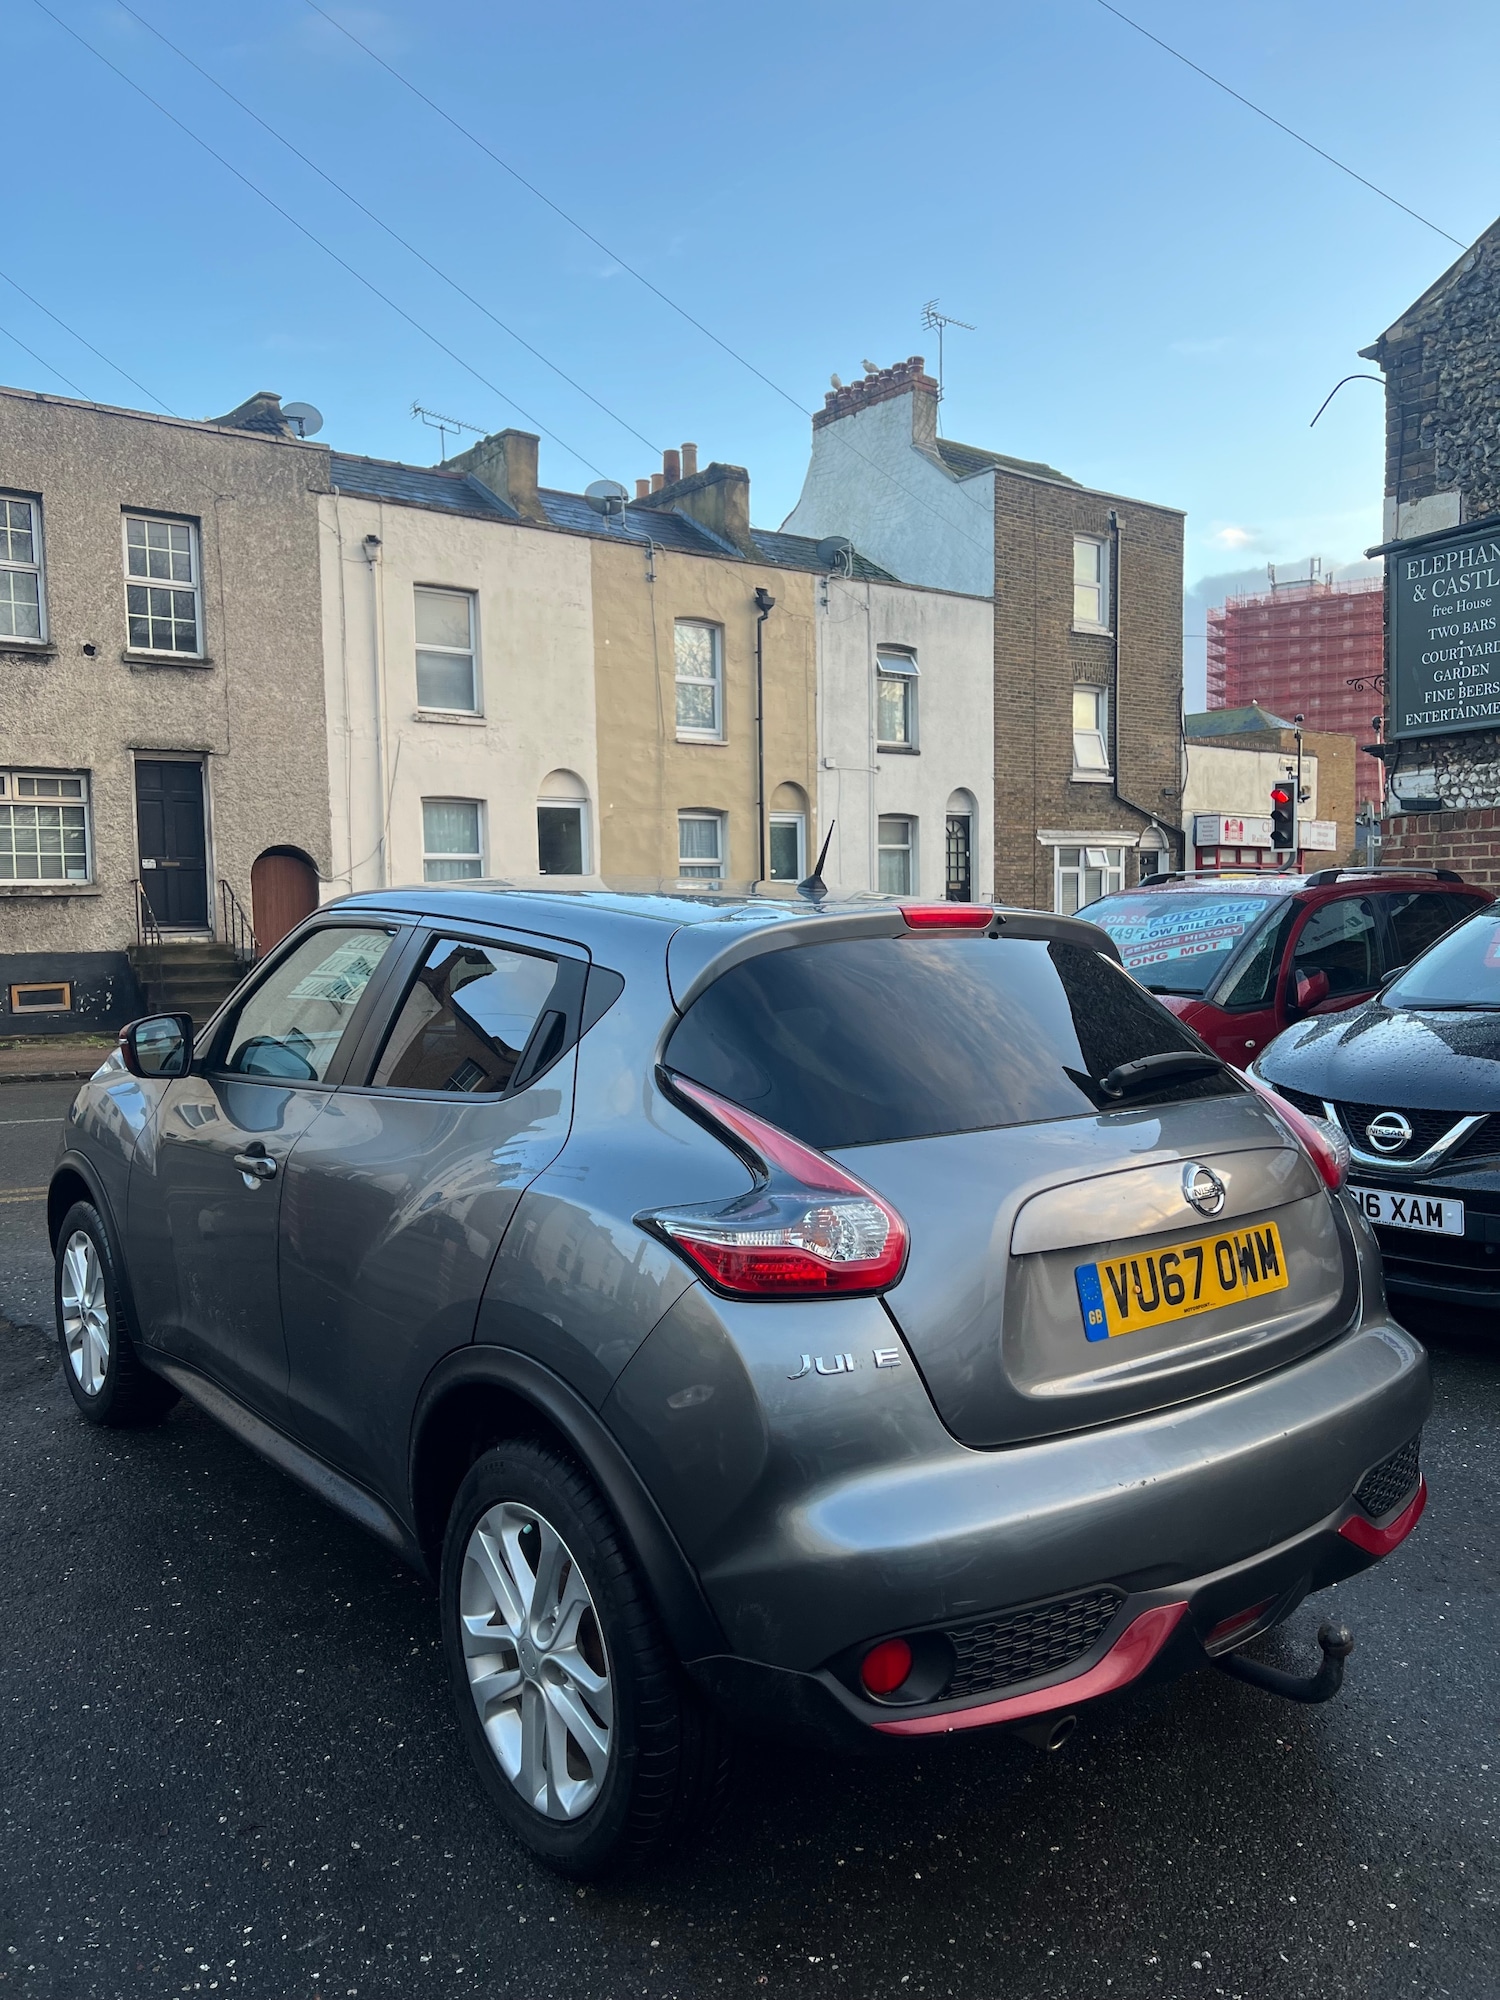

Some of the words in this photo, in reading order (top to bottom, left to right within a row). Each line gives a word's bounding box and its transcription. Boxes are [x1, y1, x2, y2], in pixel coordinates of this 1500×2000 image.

[1413, 584, 1427, 602] &
[1432, 568, 1500, 597] CASTL
[1432, 604, 1453, 617] free
[1456, 597, 1492, 613] House
[1428, 623, 1459, 640] TWO
[1463, 617, 1496, 635] BARS
[1433, 663, 1490, 682] GARDEN
[1424, 688, 1455, 703] FINE
[1459, 681, 1500, 699] BEERS
[1405, 702, 1500, 726] ENTERTAINME
[1100, 914, 1126, 924] FOR
[1151, 900, 1265, 927] AUTOMATIC
[1140, 927, 1173, 940] LOW
[1177, 914, 1246, 933] MILEAGE
[1125, 937, 1180, 954] SERVICE
[1184, 926, 1241, 943] HISTORY
[1180, 941, 1221, 956] MOT
[1370, 1126, 1405, 1137] NISSAN
[1390, 1196, 1443, 1228] XAM
[1105, 1246, 1204, 1319] VU67
[1214, 1228, 1280, 1291] OWM
[1088, 1309, 1103, 1326] GB
